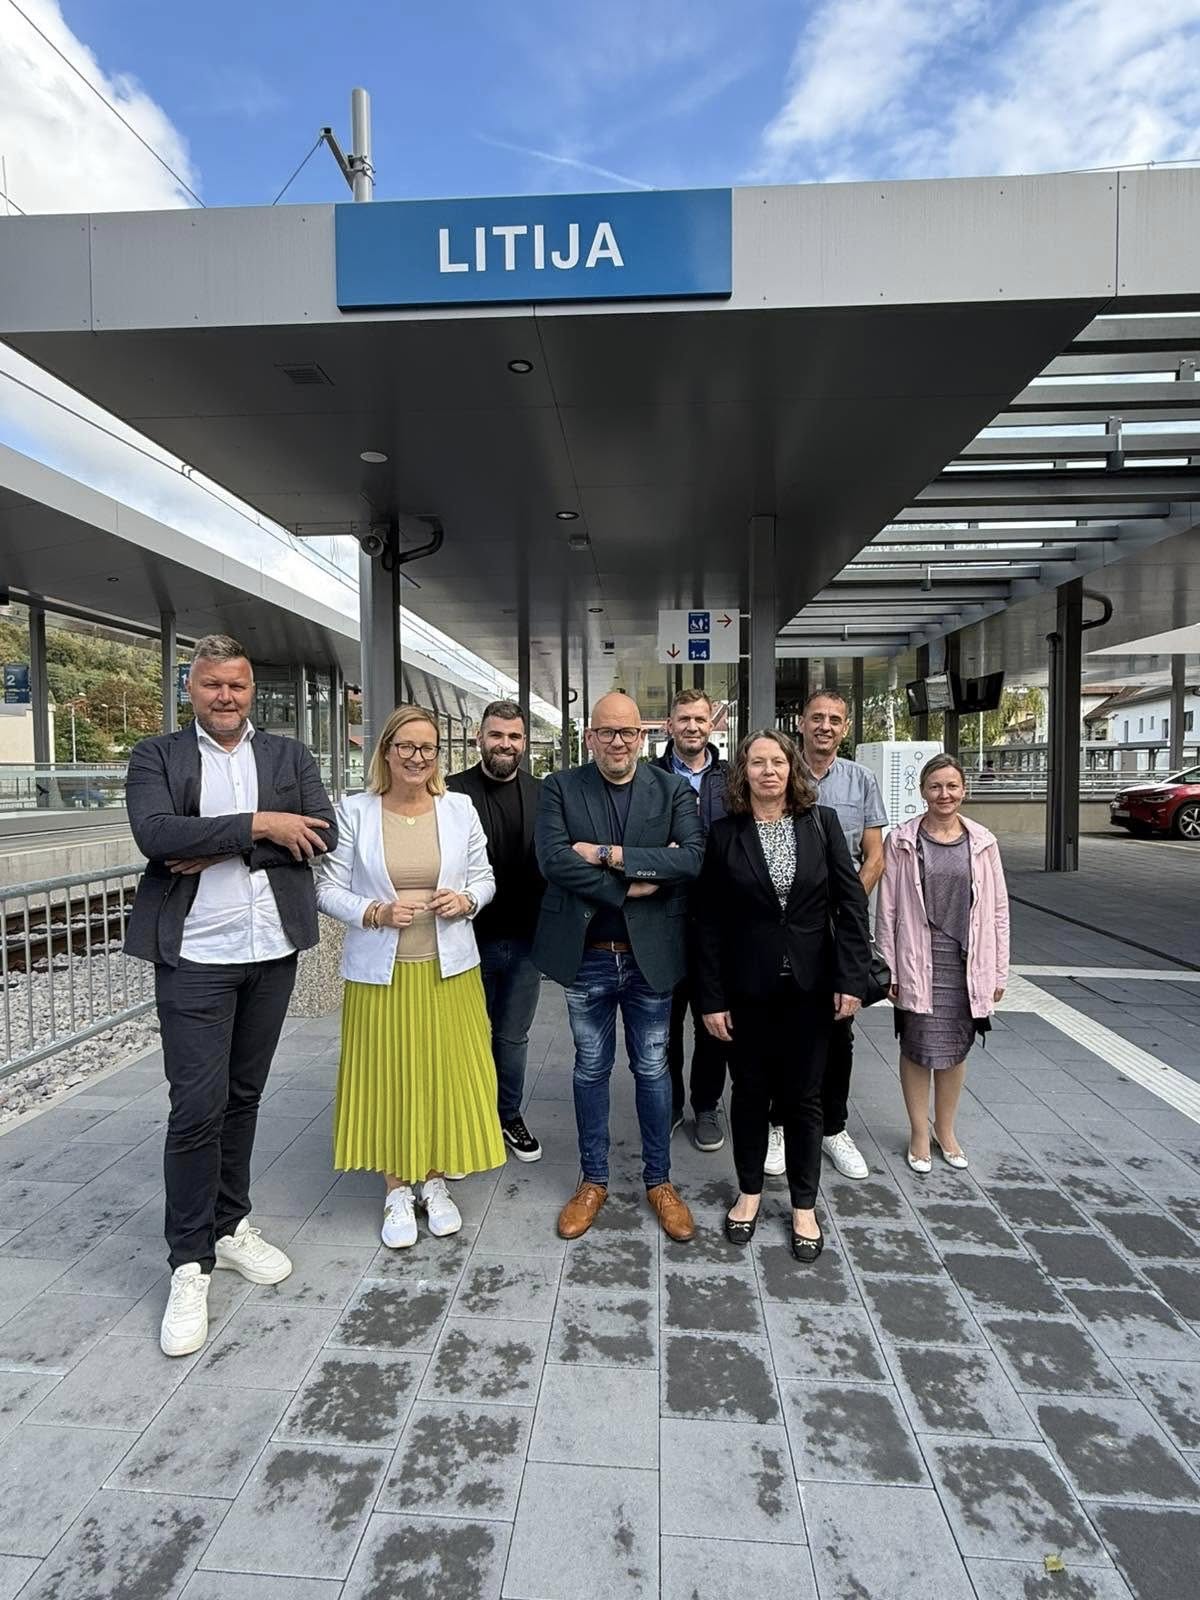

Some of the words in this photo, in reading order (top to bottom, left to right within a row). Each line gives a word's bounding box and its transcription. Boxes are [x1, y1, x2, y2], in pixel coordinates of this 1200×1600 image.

[439, 222, 625, 273] LITIJA
[690, 651, 707, 659] 1-4
[7, 675, 16, 685] 2
